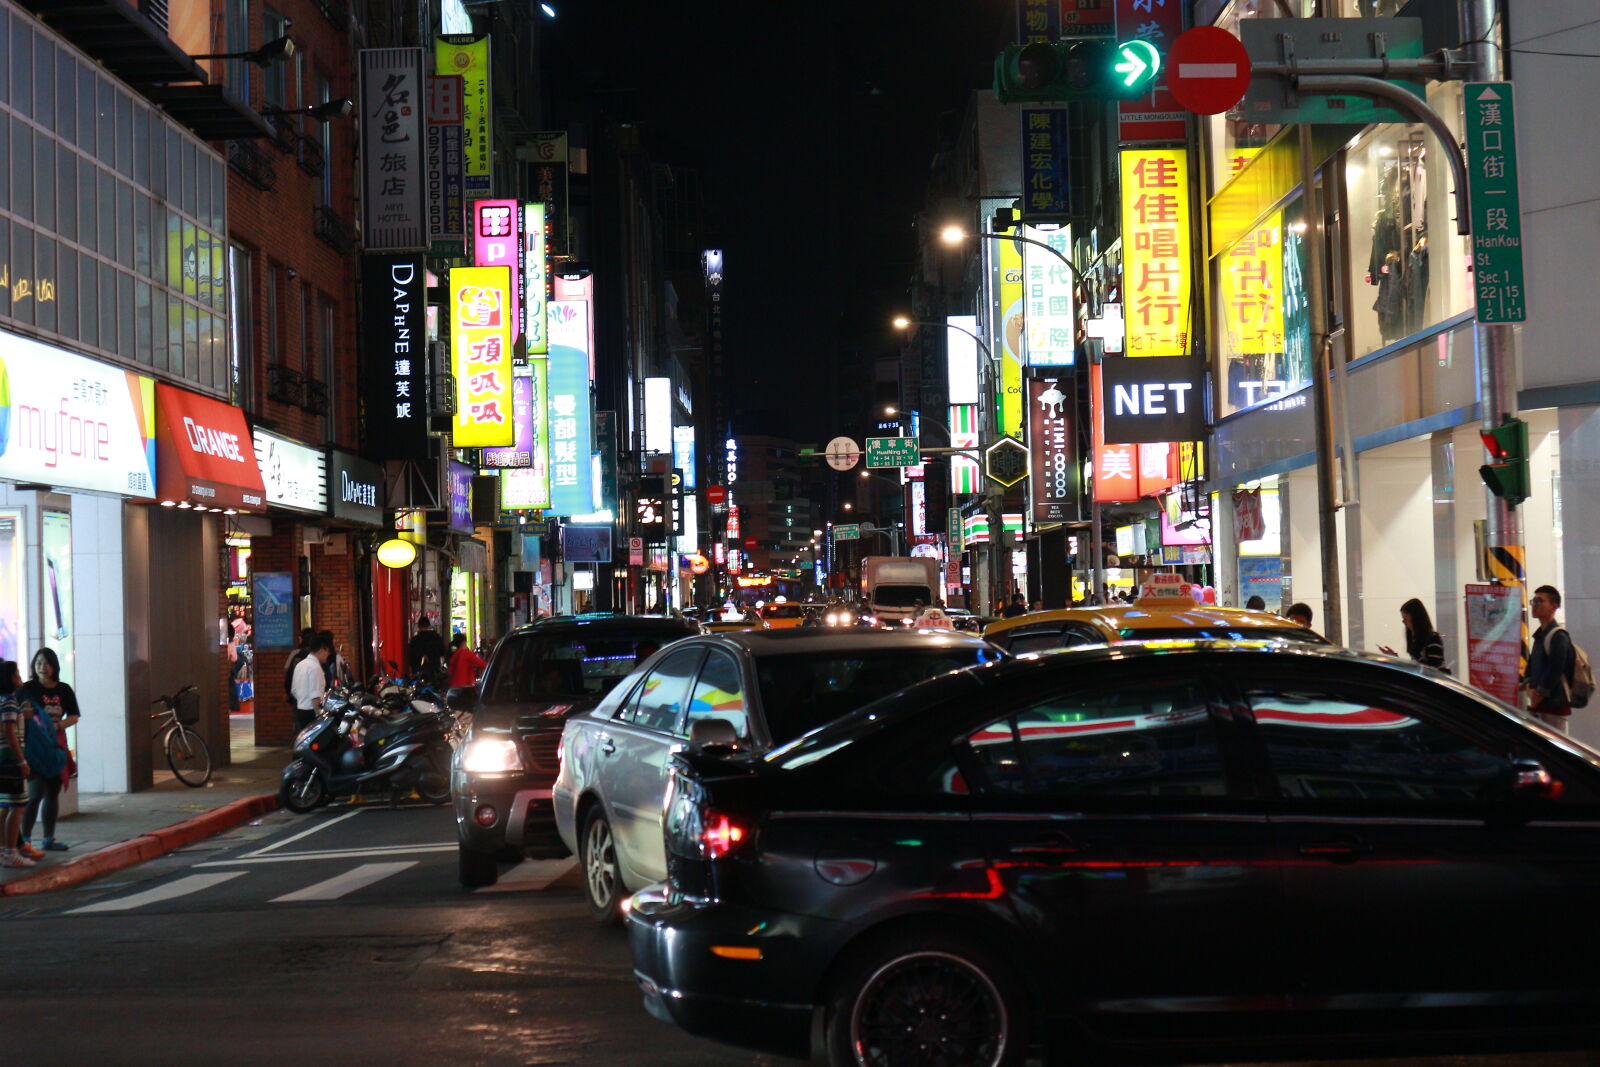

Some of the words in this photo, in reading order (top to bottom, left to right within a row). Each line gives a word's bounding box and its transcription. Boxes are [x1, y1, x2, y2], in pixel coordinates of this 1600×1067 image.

[1120, 113, 1142, 121] LITTLE
[1144, 112, 1185, 120] MONGOLIAN
[1479, 103, 1509, 231] 漢口街一段
[378, 213, 411, 223] HOTEL
[385, 203, 403, 211] MIYI
[1133, 158, 1181, 326] 佳佳唱片行
[1476, 236, 1519, 248] HanKou
[1477, 252, 1493, 266] St.
[1030, 265, 1045, 317] 英日語
[1047, 233, 1070, 347] 時代國際
[1478, 271, 1501, 283] Sec.
[1503, 270, 1510, 282] 1
[1480, 287, 1497, 298] 22
[1505, 286, 1519, 297] 15
[392, 264, 413, 354] DAPHNE
[1485, 308, 1494, 320] 2
[1506, 308, 1522, 319] 1-1
[1130, 331, 1188, 350] 地下一樓
[395, 359, 412, 418] 達芙妮
[469, 336, 502, 423] 頂呱呱
[1114, 383, 1193, 416] NET
[18, 396, 110, 468] myfone
[554, 395, 580, 486] 曼都髮型
[1102, 449, 1132, 480] 美
[1144, 585, 1157, 597] 大
